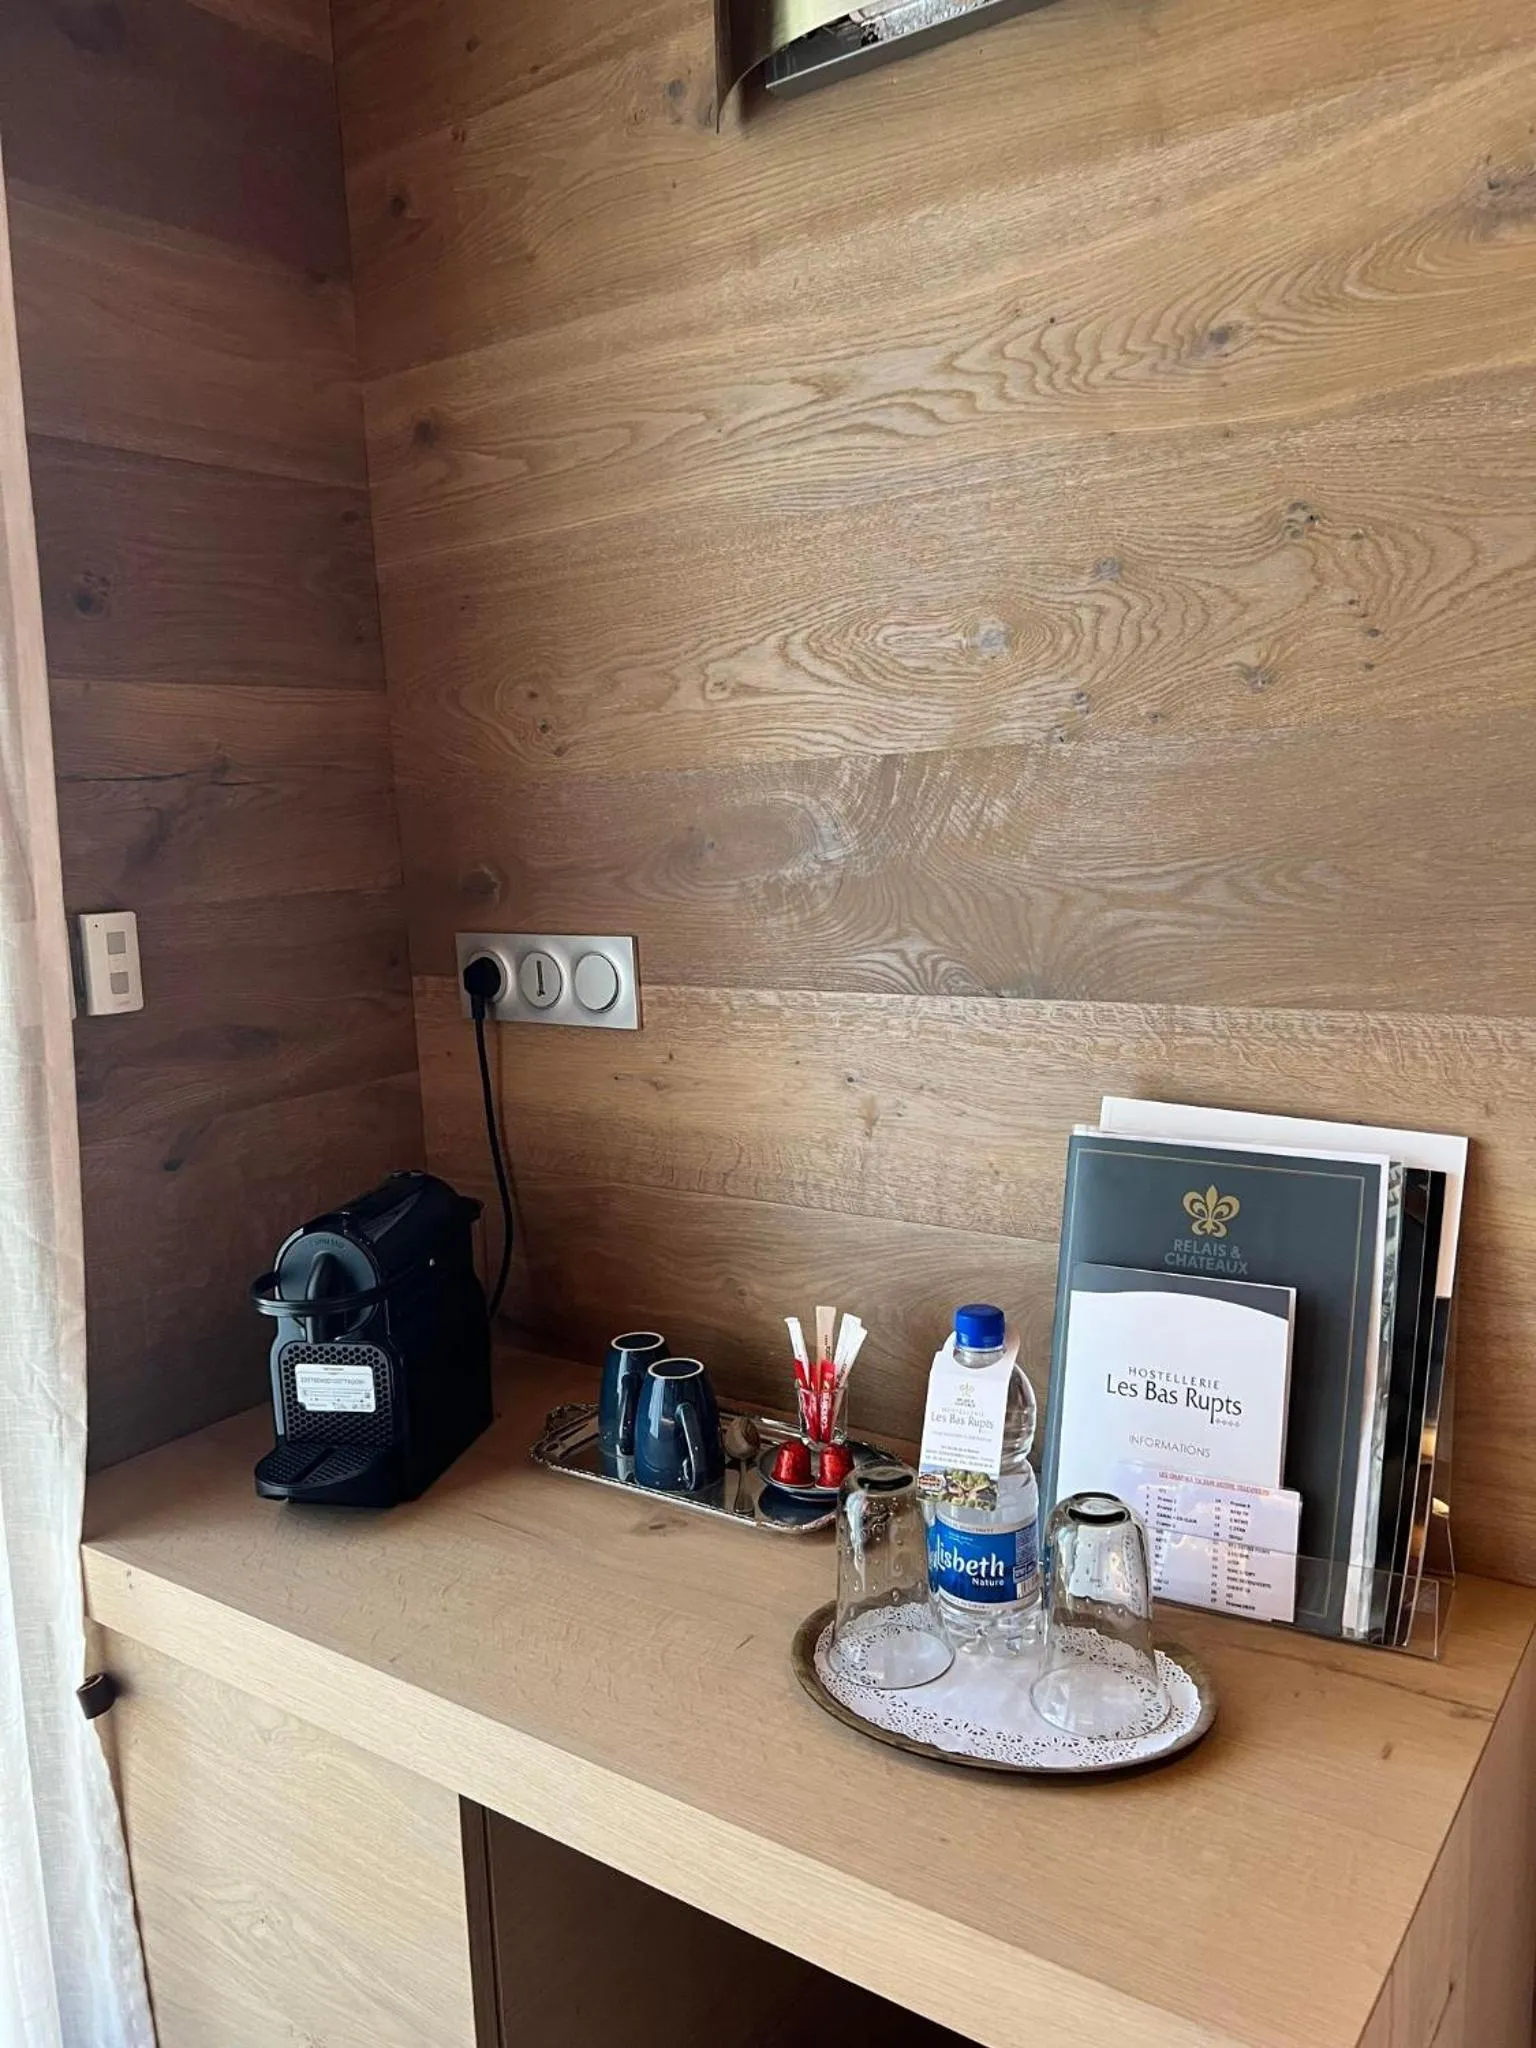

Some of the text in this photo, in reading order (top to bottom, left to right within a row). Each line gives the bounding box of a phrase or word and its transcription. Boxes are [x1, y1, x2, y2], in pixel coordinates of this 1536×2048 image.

[1173, 1238, 1241, 1259] RELAIS &
[1164, 1251, 1249, 1275] CHATEAUX
[1128, 1366, 1221, 1390] HOSTELLERIE
[1106, 1373, 1242, 1424] Les Bas Rupts
[1128, 1433, 1211, 1458] INFORMATIONS
[971, 1577, 1005, 1586] Nature
